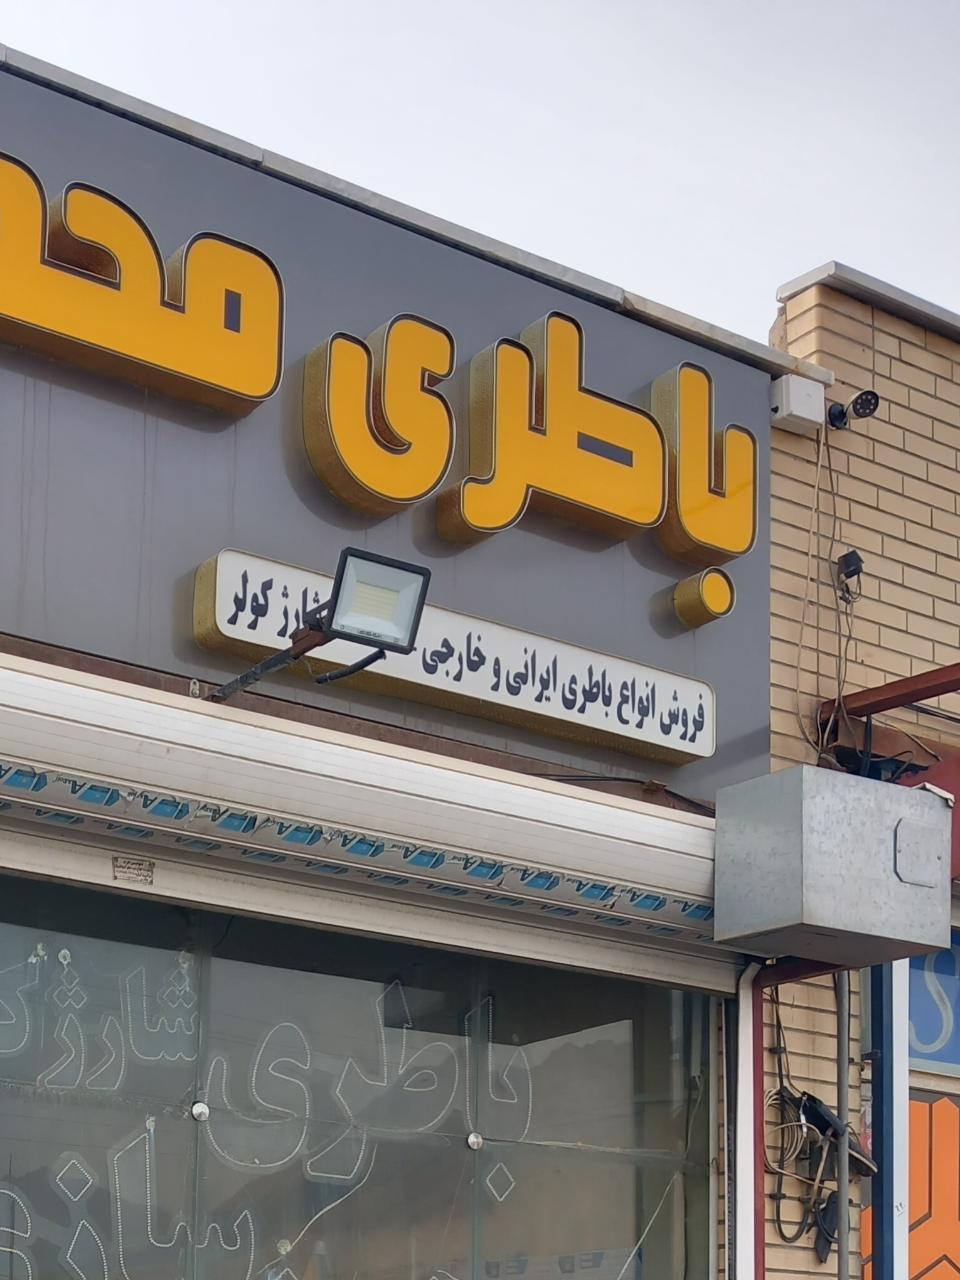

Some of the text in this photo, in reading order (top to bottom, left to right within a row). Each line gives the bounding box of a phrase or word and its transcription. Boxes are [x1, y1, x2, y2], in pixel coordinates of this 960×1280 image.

[326, 310, 758, 618] باطری
[227, 569, 274, 631] کولر
[422, 632, 486, 682] خارجی
[491, 656, 501, 692] و
[506, 647, 558, 703] ایرانی
[561, 664, 612, 718] باطری
[617, 677, 656, 729] انواع
[660, 689, 705, 743] فروش
[42, 960, 198, 1090] شارژ
[202, 979, 533, 1203] باطری
